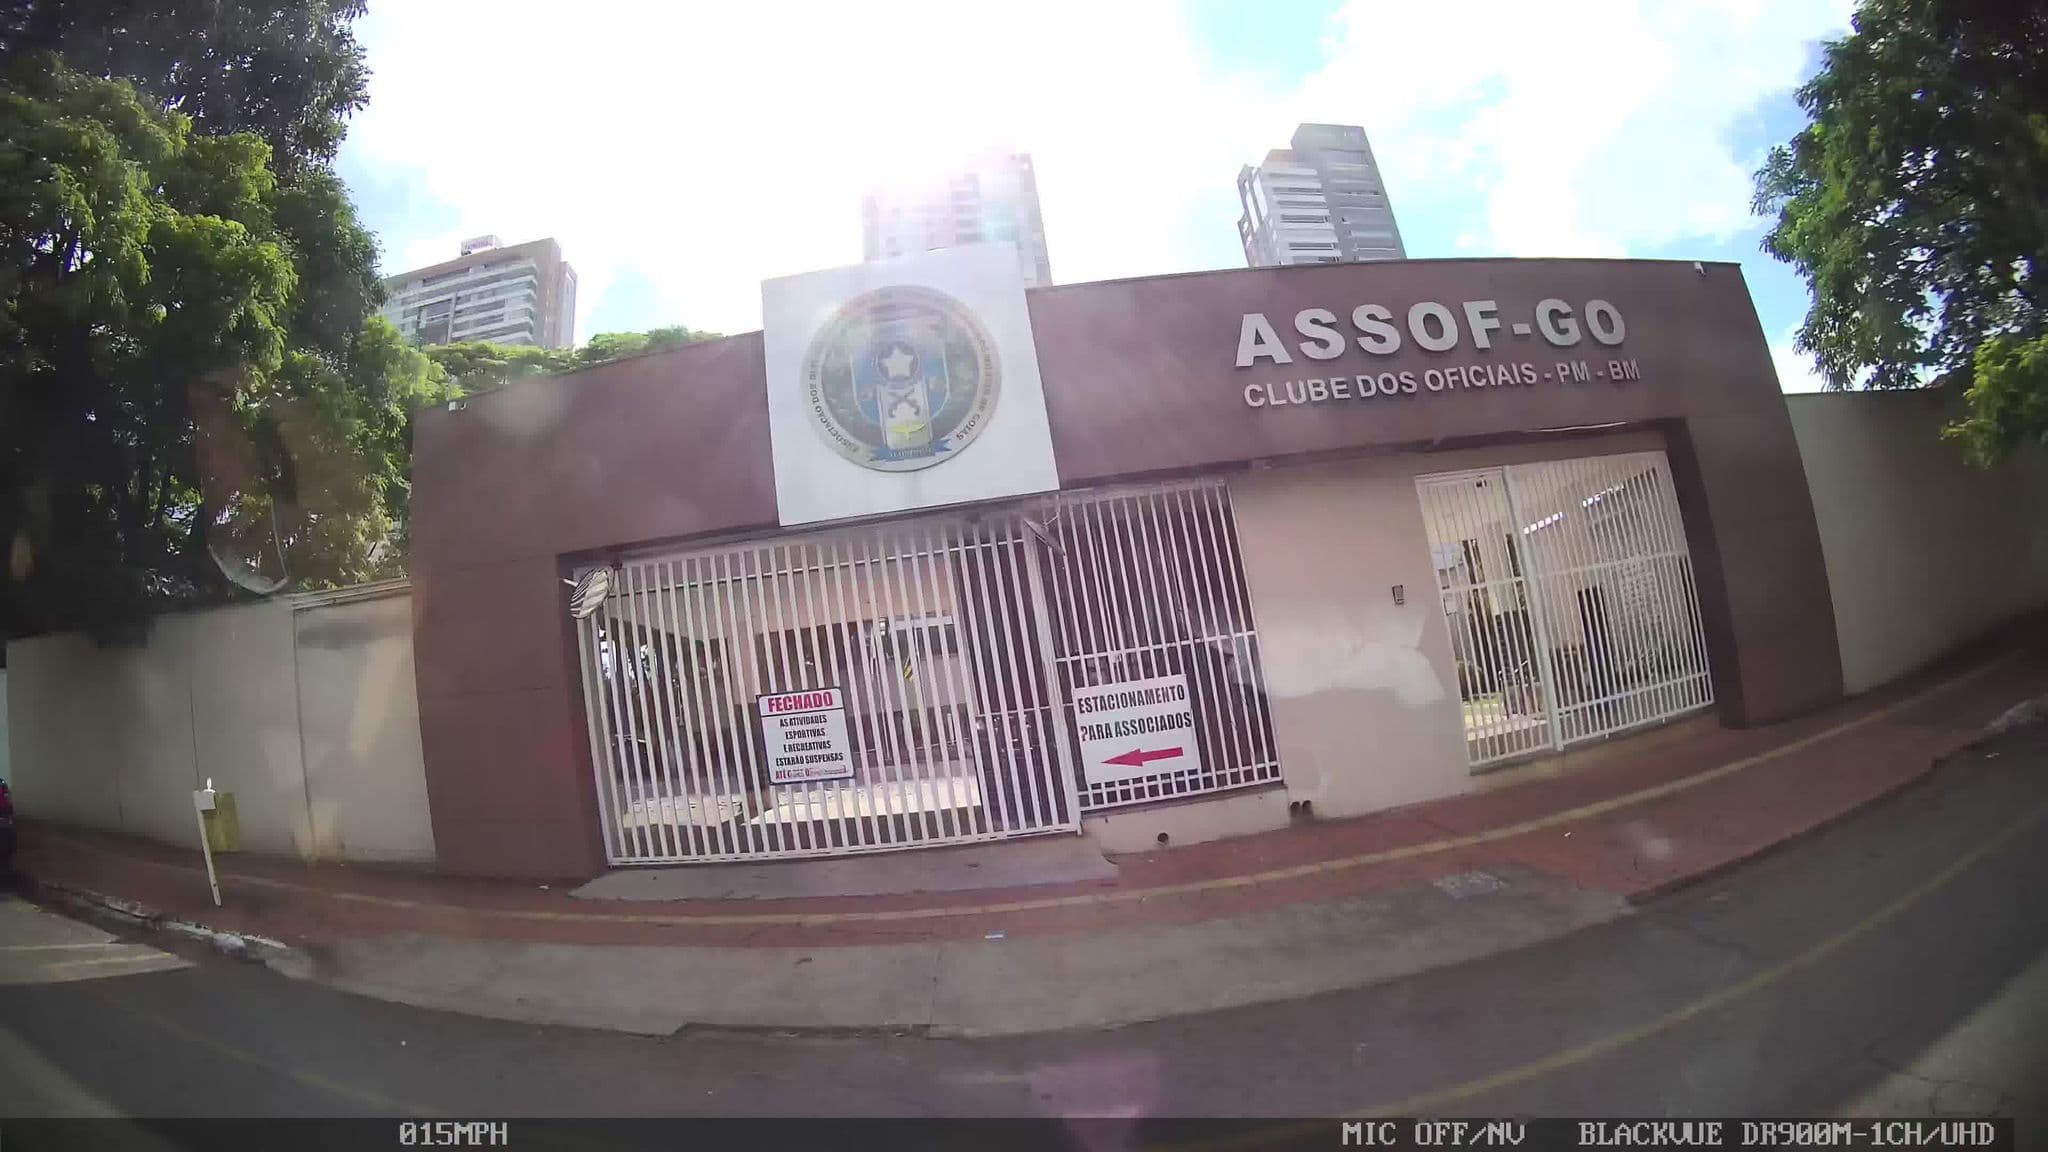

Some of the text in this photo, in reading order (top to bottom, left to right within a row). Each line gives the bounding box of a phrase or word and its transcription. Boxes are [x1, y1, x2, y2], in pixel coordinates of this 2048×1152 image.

[1235, 298, 1626, 367] ASSOF-GO
[1244, 376, 1352, 408] CLUBE
[1357, 371, 1418, 397] DOS
[1424, 362, 1538, 392] OFICIAIS
[1555, 361, 1590, 384] PM
[1608, 358, 1641, 382] BM
[768, 691, 834, 713] FECHADO
[1078, 684, 1185, 714] ESTACIONAMENTO
[780, 714, 827, 728] AS ATIVIDADES
[1080, 711, 1192, 742] PARA ASSOCIADOS
[785, 728, 826, 740] ESPORTIVAS
[784, 740, 832, 753] E RECREATIVAS
[805, 752, 844, 765] SUSPENSAS
